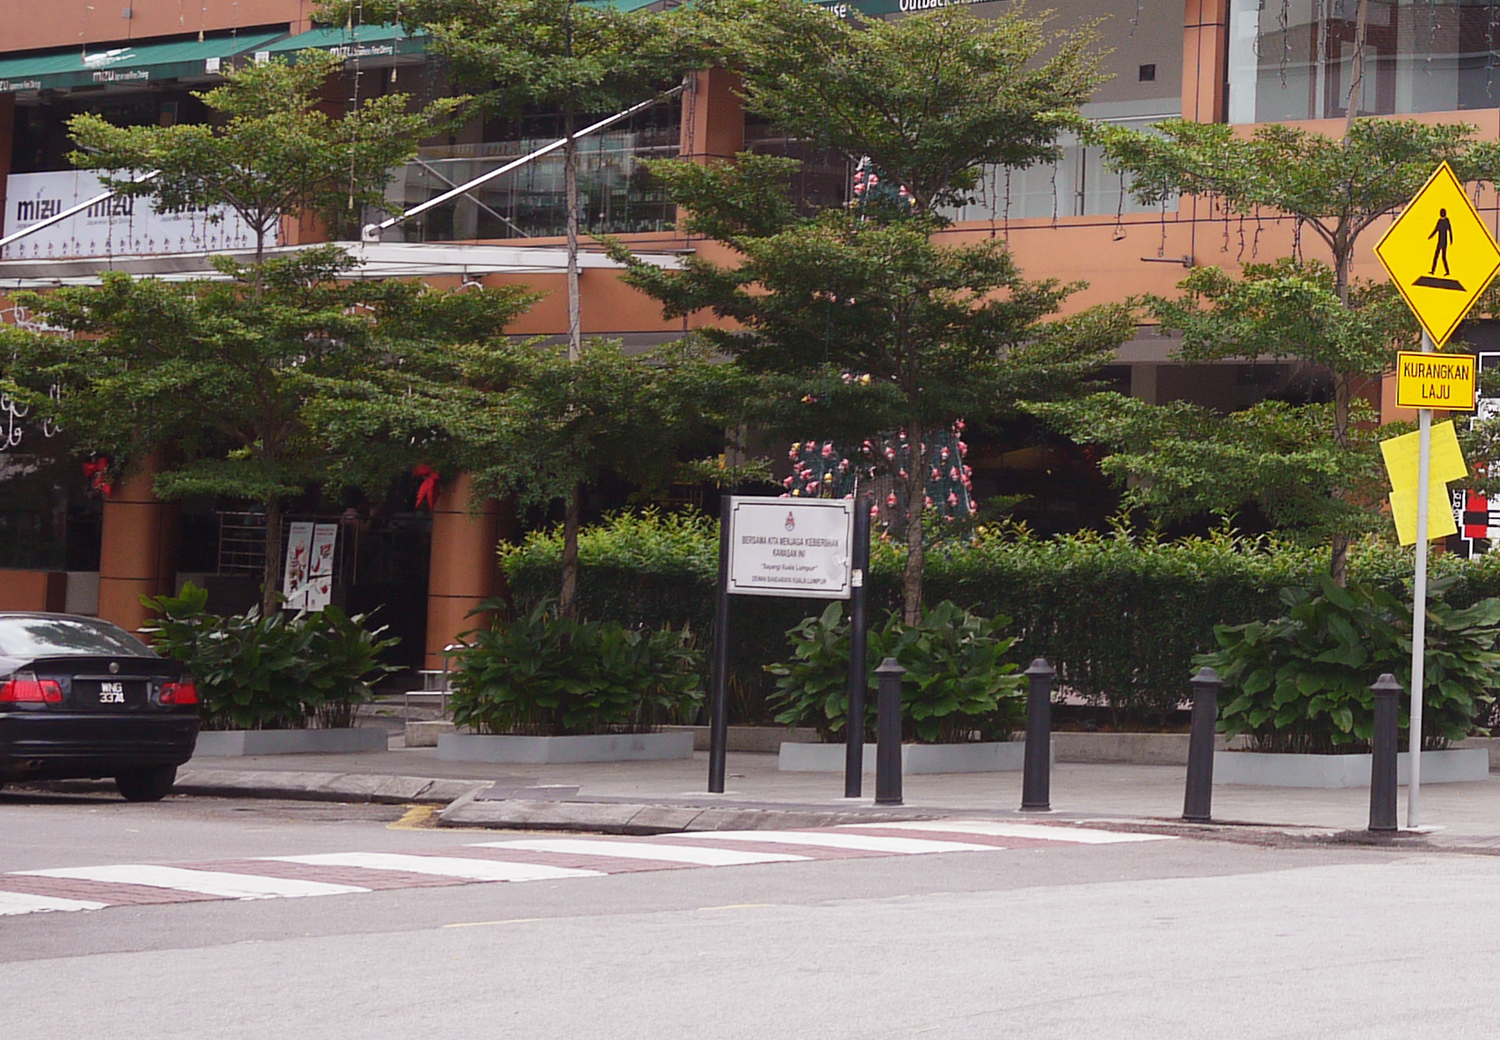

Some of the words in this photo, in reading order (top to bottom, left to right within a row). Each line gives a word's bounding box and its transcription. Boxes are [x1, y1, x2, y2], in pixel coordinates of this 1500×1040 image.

[17, 197, 62, 221] mizu
[1403, 362, 1469, 381] KURANGKAN
[1421, 383, 1450, 400] LAJU
[101, 682, 123, 692] WNG
